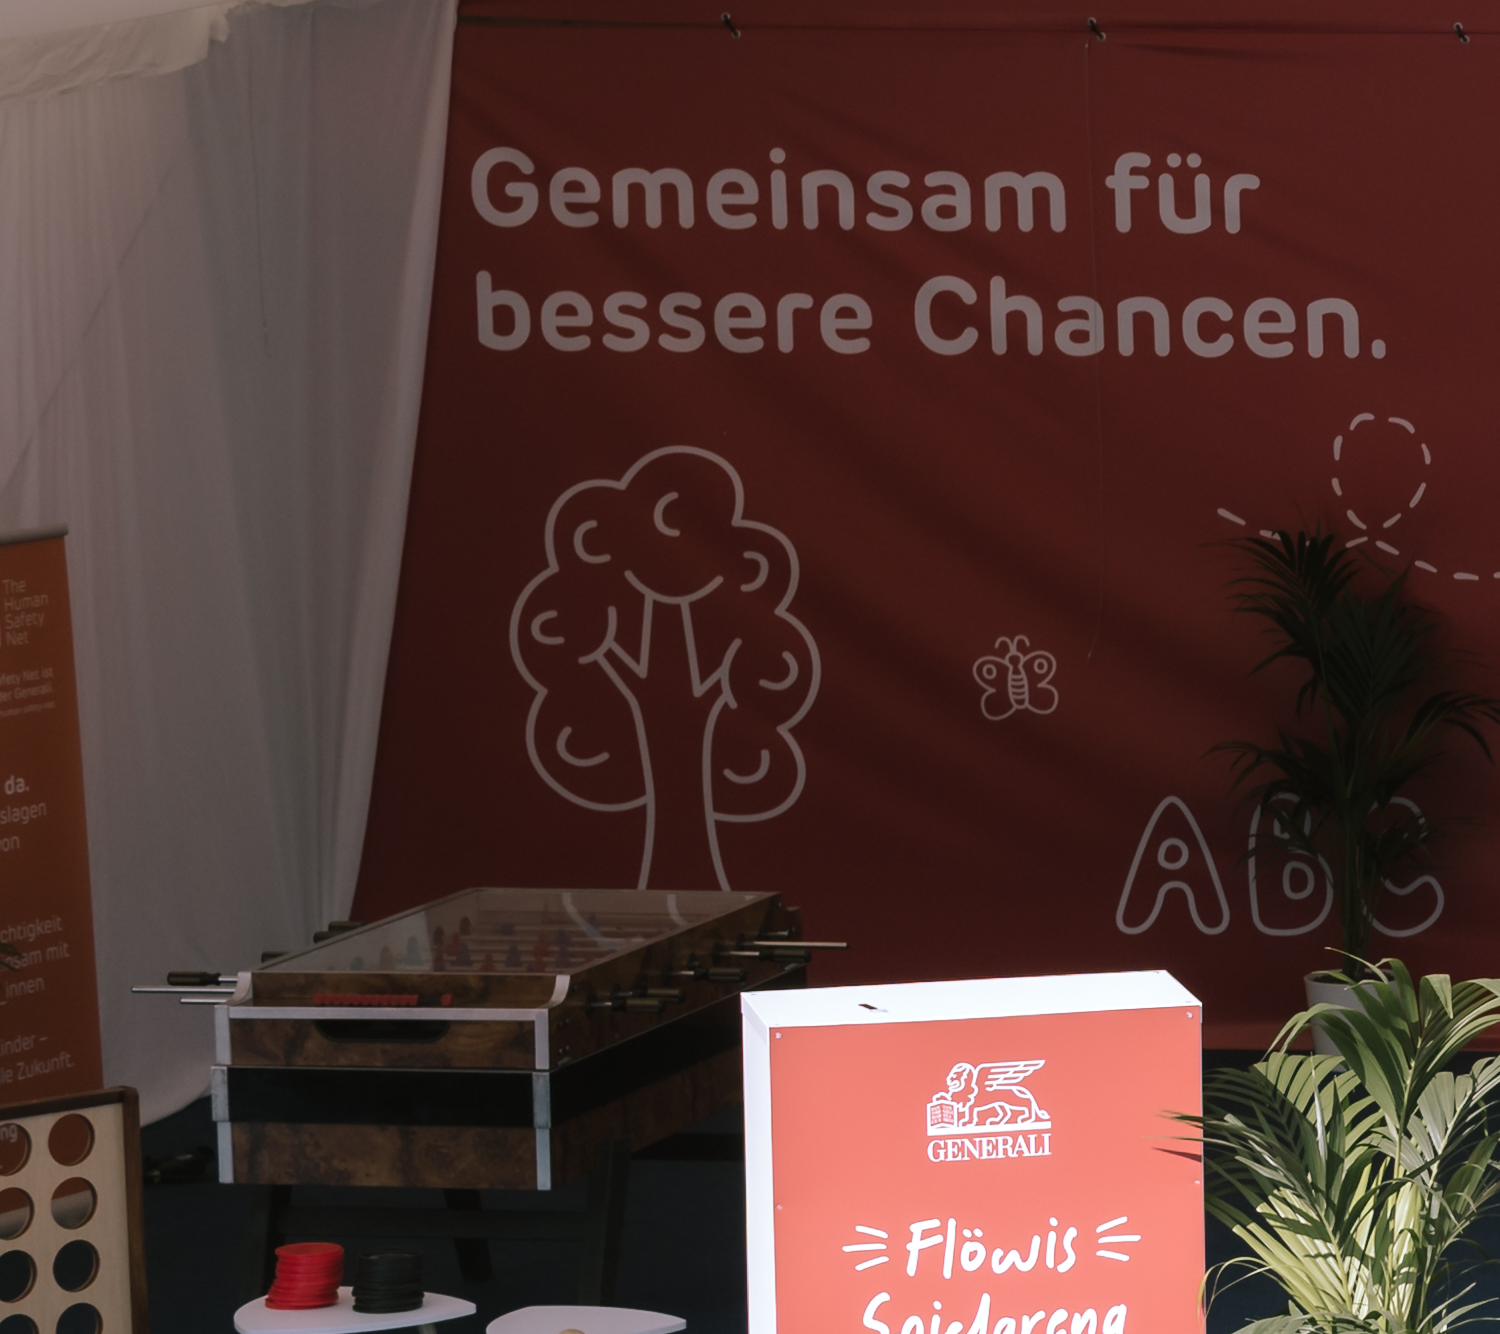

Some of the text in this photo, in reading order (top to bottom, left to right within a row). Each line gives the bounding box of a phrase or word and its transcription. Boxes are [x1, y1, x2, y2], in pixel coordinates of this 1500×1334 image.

[470, 145, 1262, 235] Gemeinsam für
[475, 269, 1388, 360] bessere Chancen.
[2, 578, 27, 595] The
[4, 594, 49, 613] Human
[5, 611, 46, 631] Safety
[6, 630, 30, 647] Net
[4, 774, 30, 795] da.
[0, 1032, 37, 1057] inder
[926, 1133, 1053, 1163] GENERALI
[905, 1216, 1079, 1280] Flöwis
